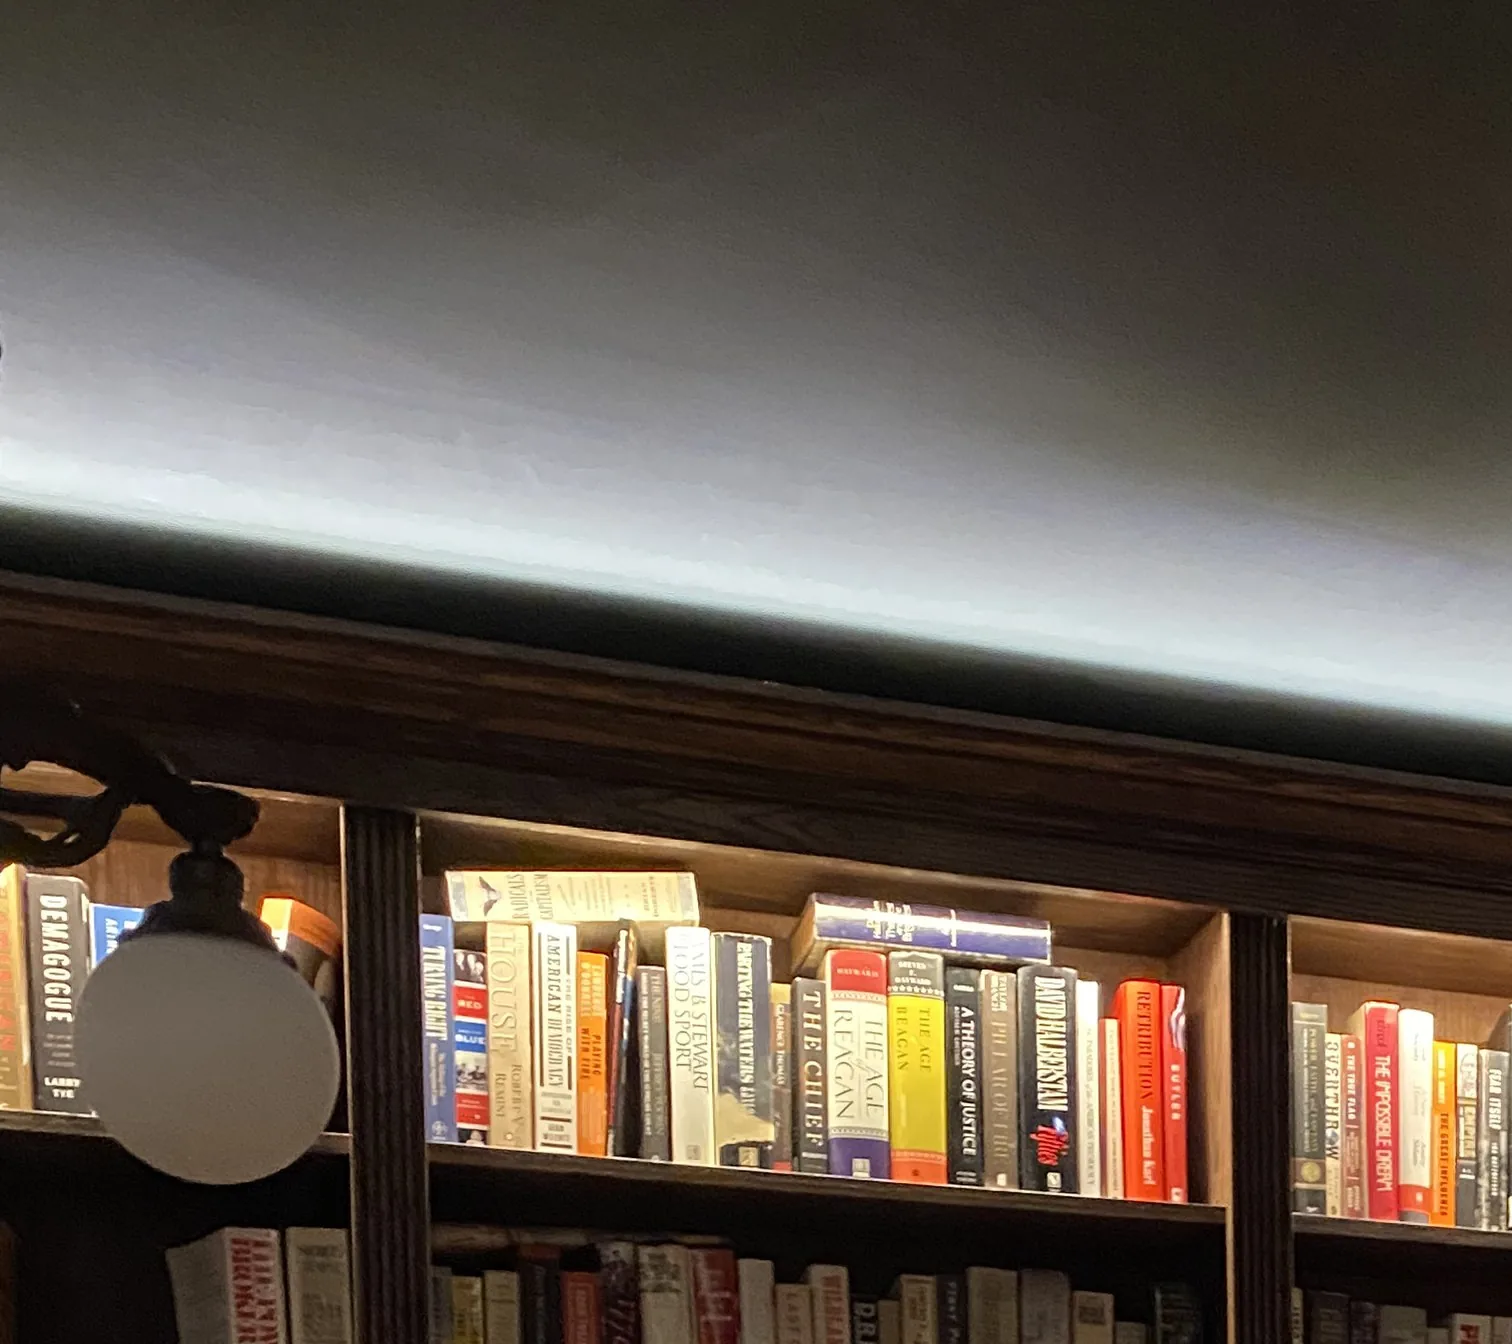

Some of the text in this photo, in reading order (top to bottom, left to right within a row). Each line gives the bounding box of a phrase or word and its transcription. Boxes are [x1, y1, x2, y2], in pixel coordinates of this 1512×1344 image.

[39, 895, 75, 1023] DEMAGOGUE
[423, 946, 447, 998] TURNING
[491, 933, 518, 1052] HOUSE
[547, 934, 562, 1014] AMERICAN
[425, 1000, 447, 1040] RIGHT
[547, 1018, 564, 1088] DEMOCRACY
[674, 1010, 692, 1071] SPORT
[690, 1012, 710, 1093] STEWART
[918, 1008, 932, 1073] THE AGE
[1035, 976, 1068, 1111] DAVID HALBERSTAM
[592, 1034, 602, 1075] PLAYING
[803, 990, 824, 1146] THE CHIEF
[834, 1009, 855, 1119] REAGAN
[865, 1021, 886, 1118] THE AGE
[961, 1006, 977, 1156] A THEORY OF JUSTICE
[1136, 991, 1156, 1184] RETRIBUTION Jonathan Karl
[1374, 1055, 1392, 1077] THE
[1375, 1081, 1392, 1147] IMPOSSIBLE
[1440, 1112, 1448, 1129] THE
[1488, 1068, 1503, 1130] FEAR ITSELF
[1376, 1149, 1392, 1191] DREAM
[1440, 1133, 1448, 1163] GREAT
